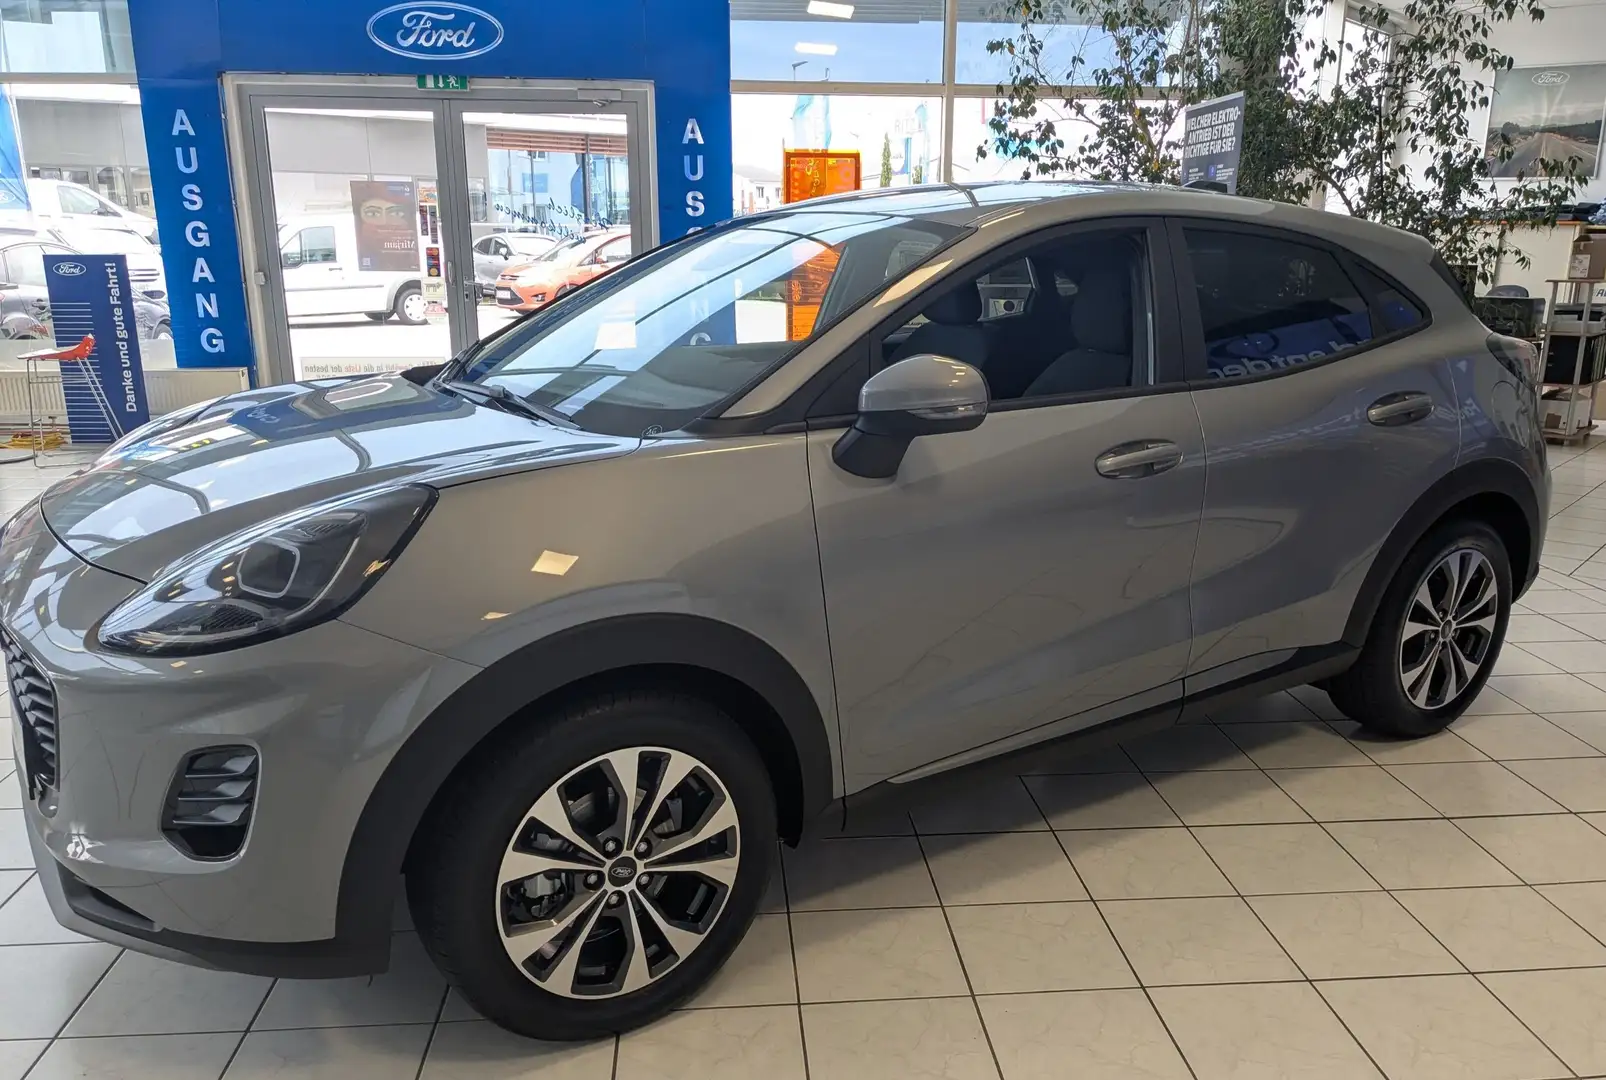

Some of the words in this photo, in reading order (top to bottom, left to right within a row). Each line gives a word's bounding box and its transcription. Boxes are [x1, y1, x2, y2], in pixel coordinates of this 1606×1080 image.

[396, 10, 476, 48] Ford
[1538, 72, 1564, 84] Ford
[1187, 113, 1211, 131] WELCHER
[1211, 106, 1240, 126] ELEKTRO-
[1188, 127, 1212, 145] ANTRIEB
[1212, 125, 1222, 140] IST
[1222, 121, 1235, 137] DER
[1184, 142, 1210, 159] RICHTIGE
[1222, 136, 1236, 153] SIE?
[171, 108, 226, 353] AUSGANG
[58, 263, 81, 275] Ford
[104, 262, 122, 305] Fahrt!
[112, 307, 128, 339] gute
[116, 342, 130, 368] und
[122, 370, 137, 412] Danke
